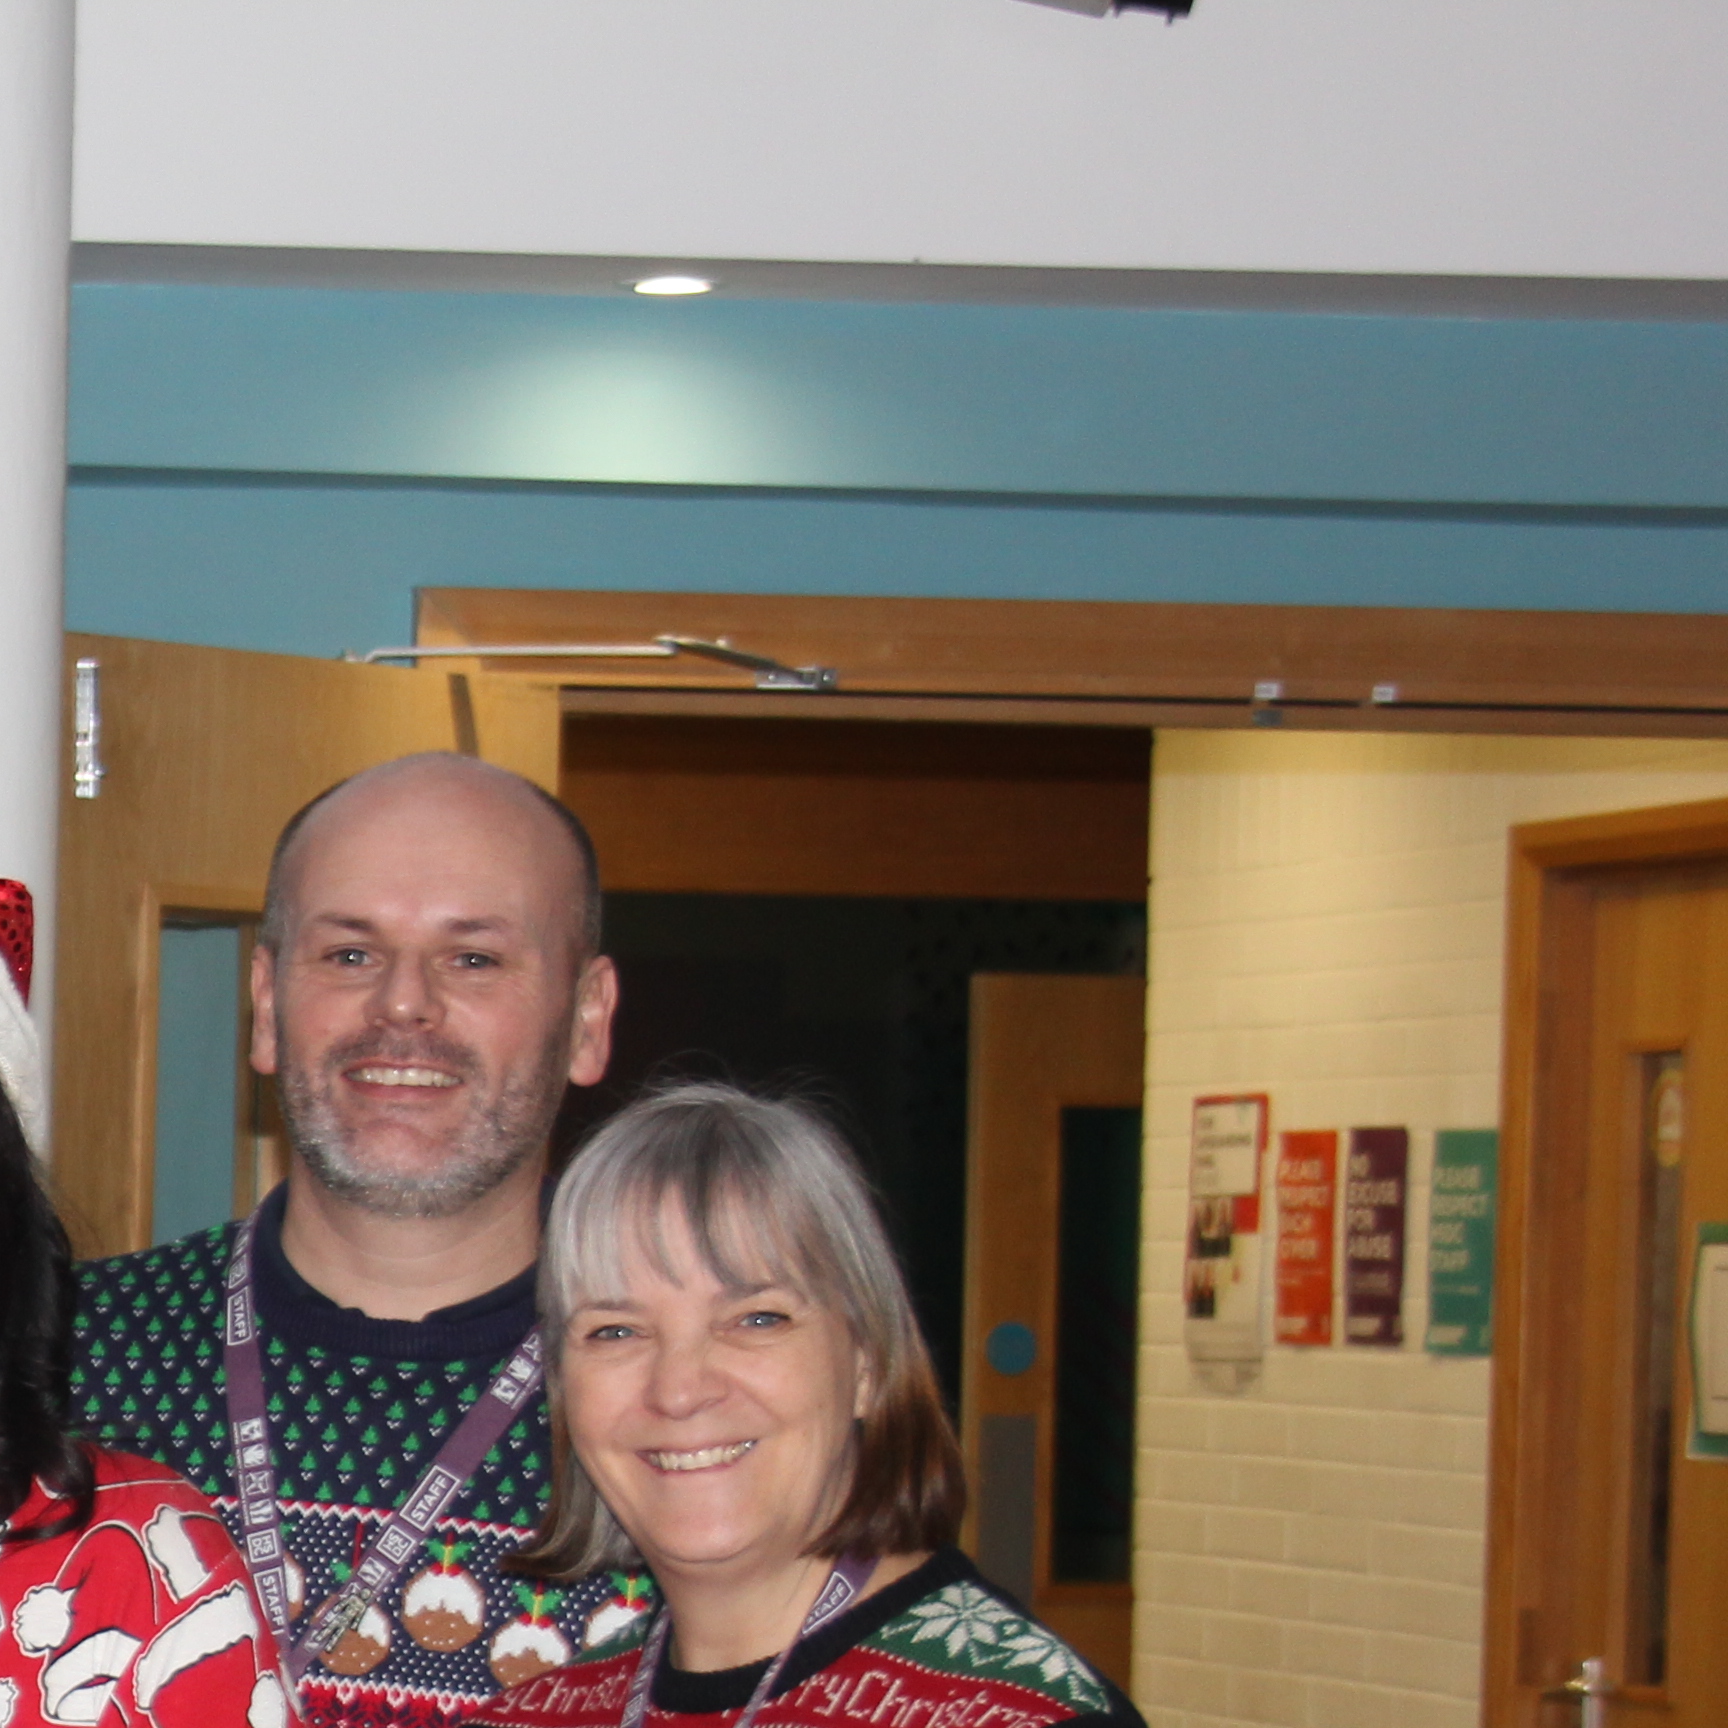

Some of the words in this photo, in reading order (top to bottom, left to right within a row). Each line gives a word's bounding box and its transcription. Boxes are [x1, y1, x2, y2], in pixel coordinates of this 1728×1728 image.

[232, 1300, 246, 1340] STAFF
[410, 1474, 450, 1521] STAFF
[262, 1576, 284, 1630] STAFF
